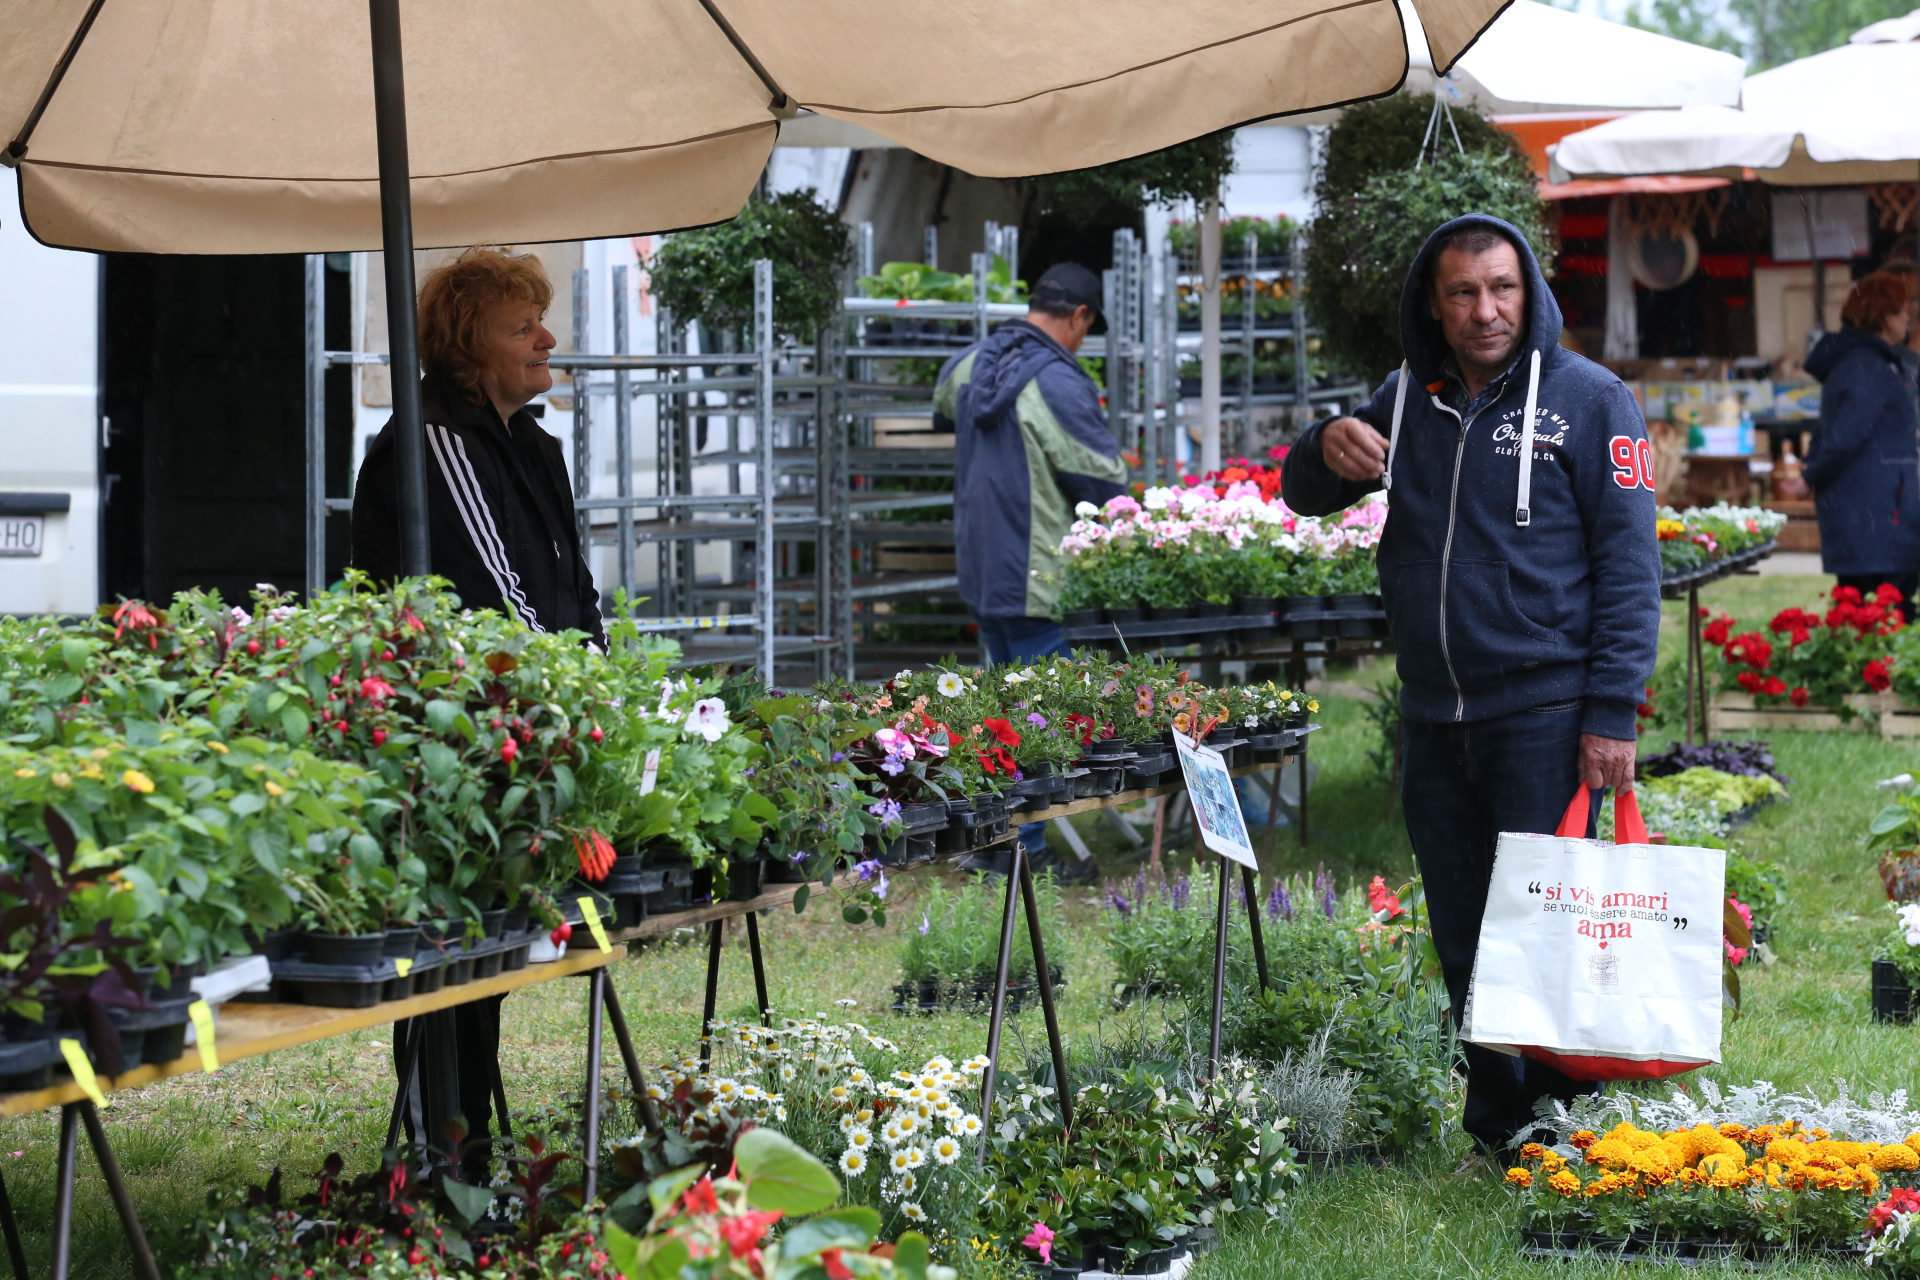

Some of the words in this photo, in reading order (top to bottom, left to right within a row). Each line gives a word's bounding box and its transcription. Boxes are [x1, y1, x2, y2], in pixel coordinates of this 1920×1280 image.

[1502, 408, 1549, 421] CRAED
[1550, 413, 1570, 431] MFG
[1492, 423, 1565, 449] Orinals
[1609, 435, 1655, 492] 90
[1570, 886, 1595, 906] vis
[1601, 891, 1668, 911] amari
[1543, 902, 1557, 912] se
[1560, 903, 1588, 915] vuoi
[1590, 908, 1627, 920] essere
[1577, 918, 1633, 940] ama
